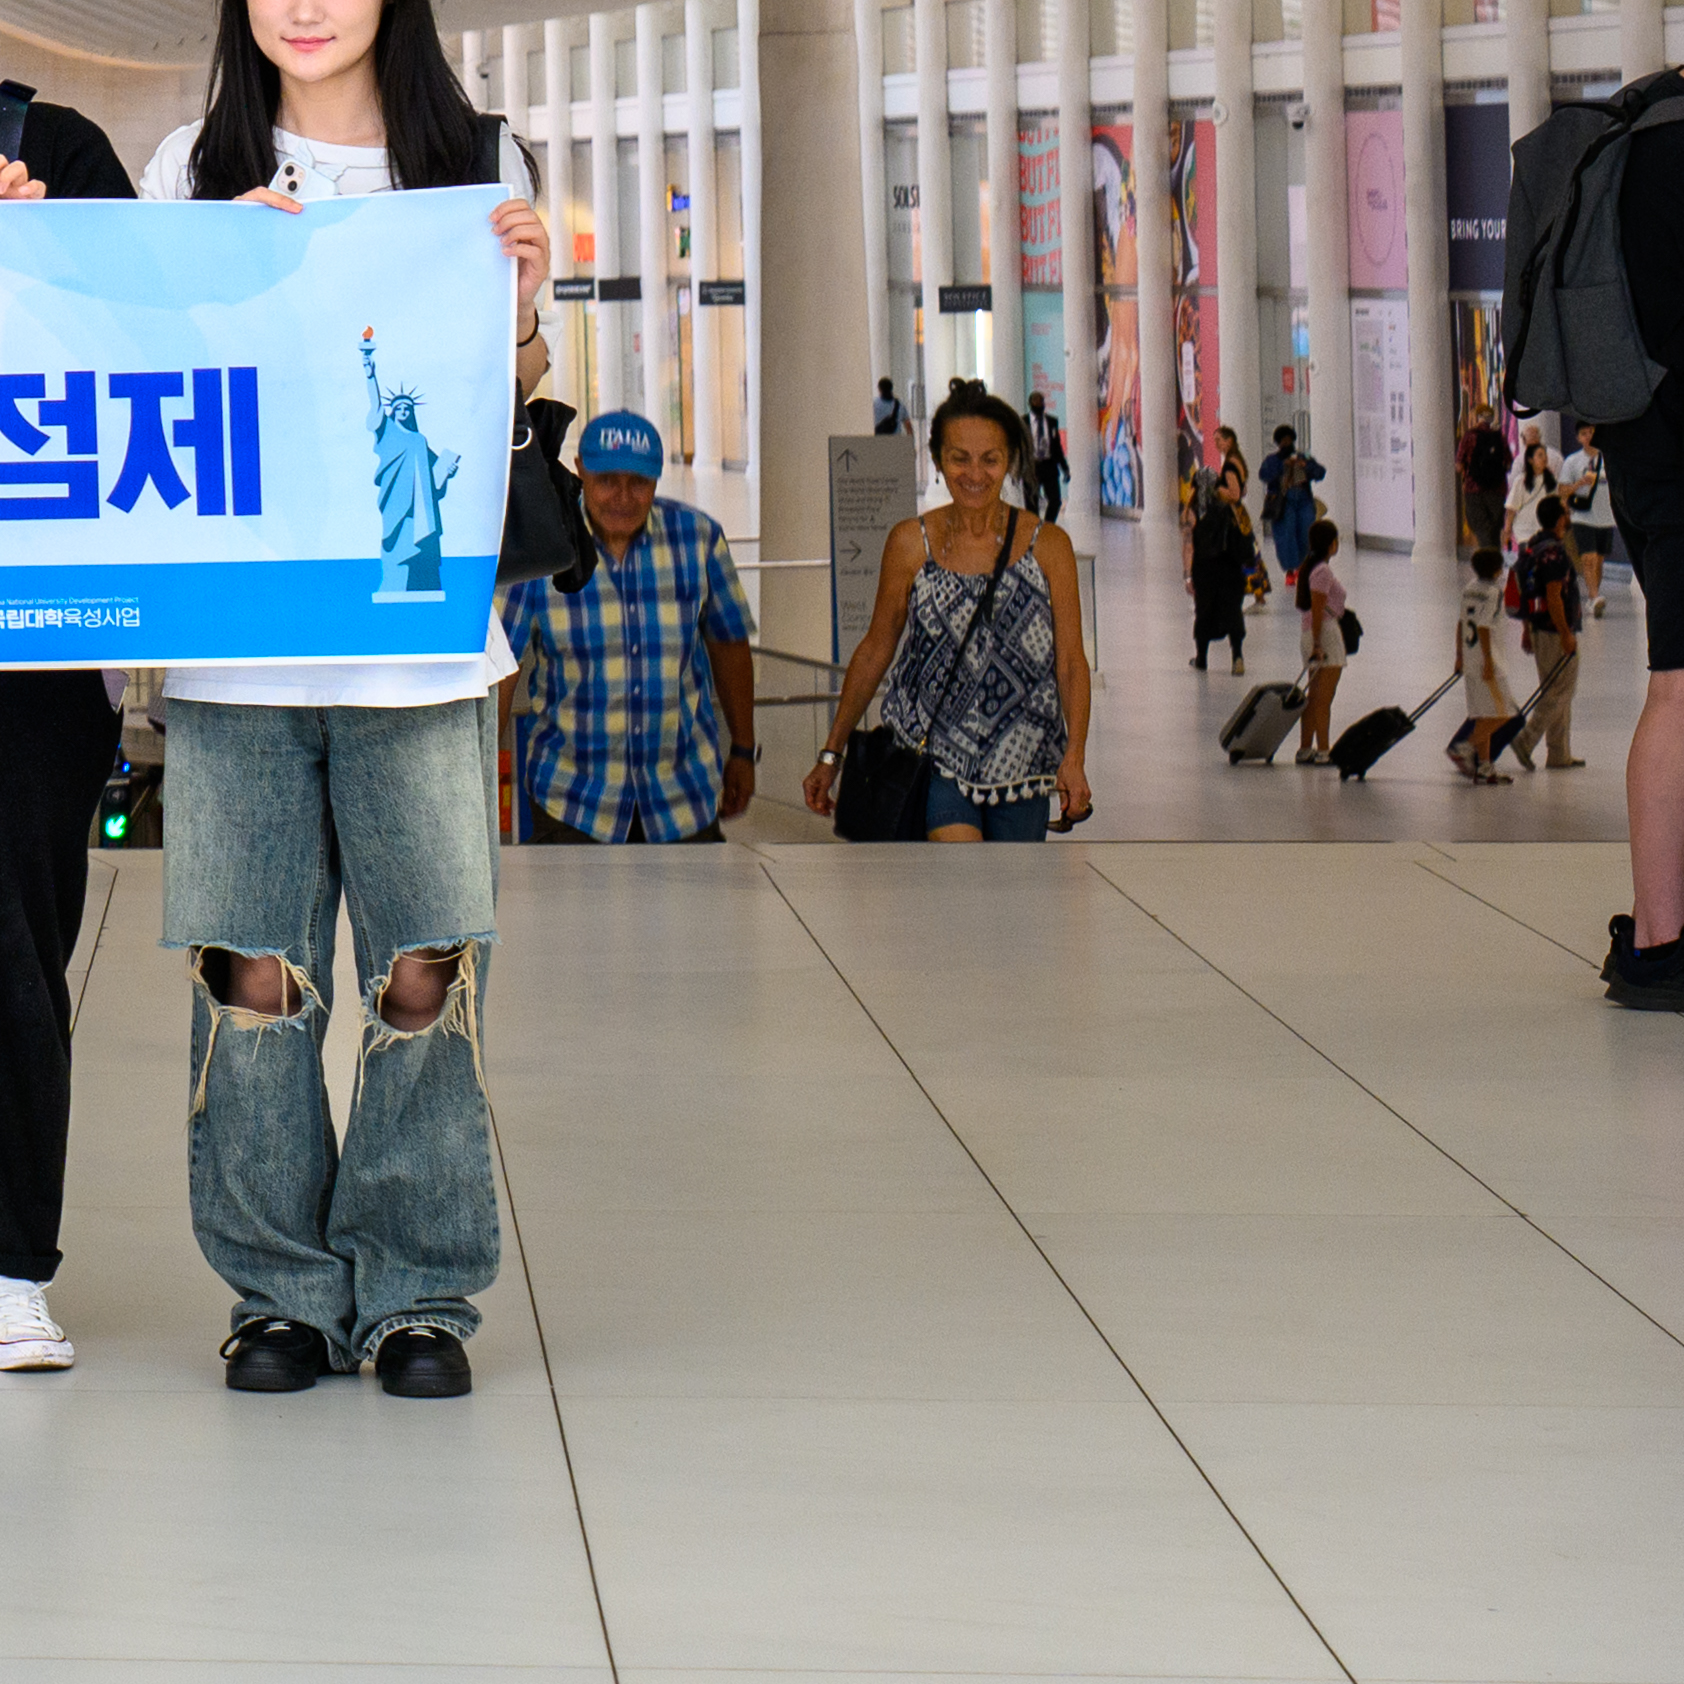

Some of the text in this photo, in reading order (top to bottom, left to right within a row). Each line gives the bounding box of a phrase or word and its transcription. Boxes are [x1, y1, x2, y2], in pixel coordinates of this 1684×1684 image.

[1451, 219, 1507, 240] BRING YOUR
[600, 427, 650, 450] ITALIA
[7, 598, 34, 606] National
[35, 597, 68, 606] University
[69, 597, 114, 605] Development
